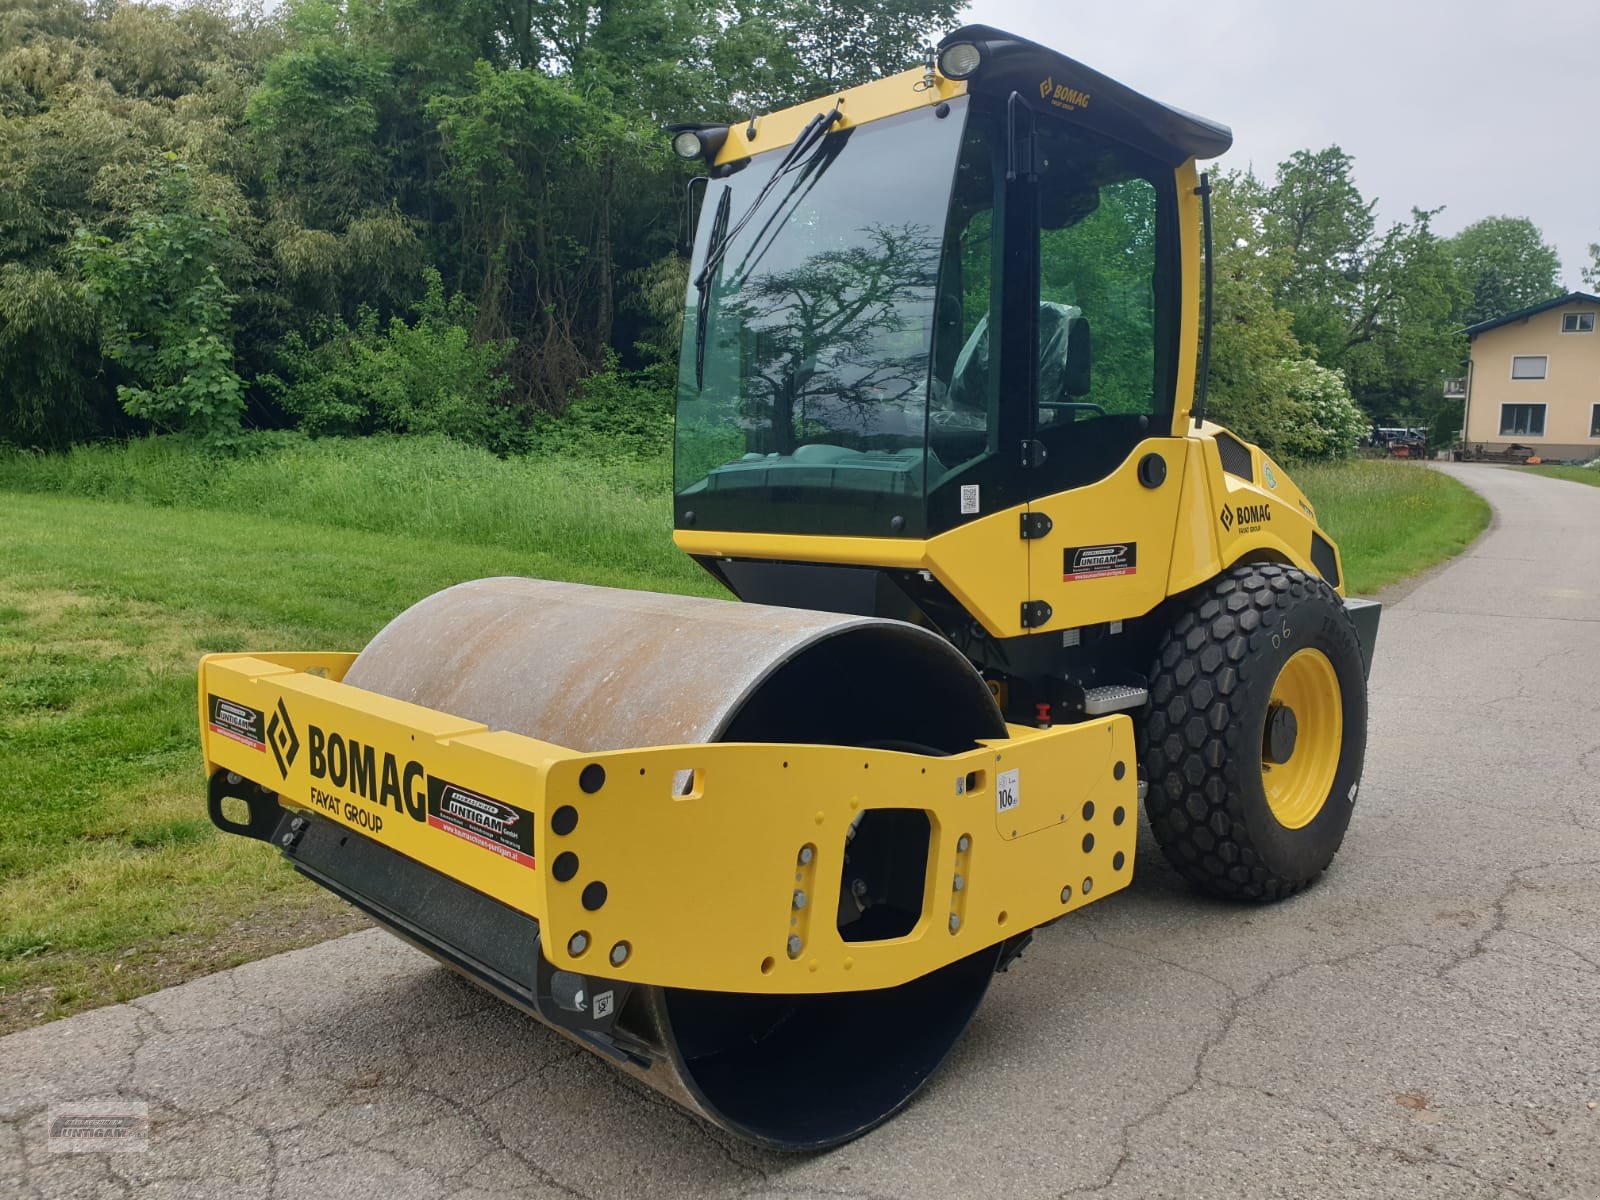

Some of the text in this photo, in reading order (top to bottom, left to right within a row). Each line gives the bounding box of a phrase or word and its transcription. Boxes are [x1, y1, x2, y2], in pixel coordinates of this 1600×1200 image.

[1053, 84, 1090, 107] BOMAG
[1236, 503, 1271, 525] BOMAG
[308, 724, 426, 823] BOMAG
[310, 786, 383, 834] FAYAT GROUP
[998, 788, 1013, 809] 106
